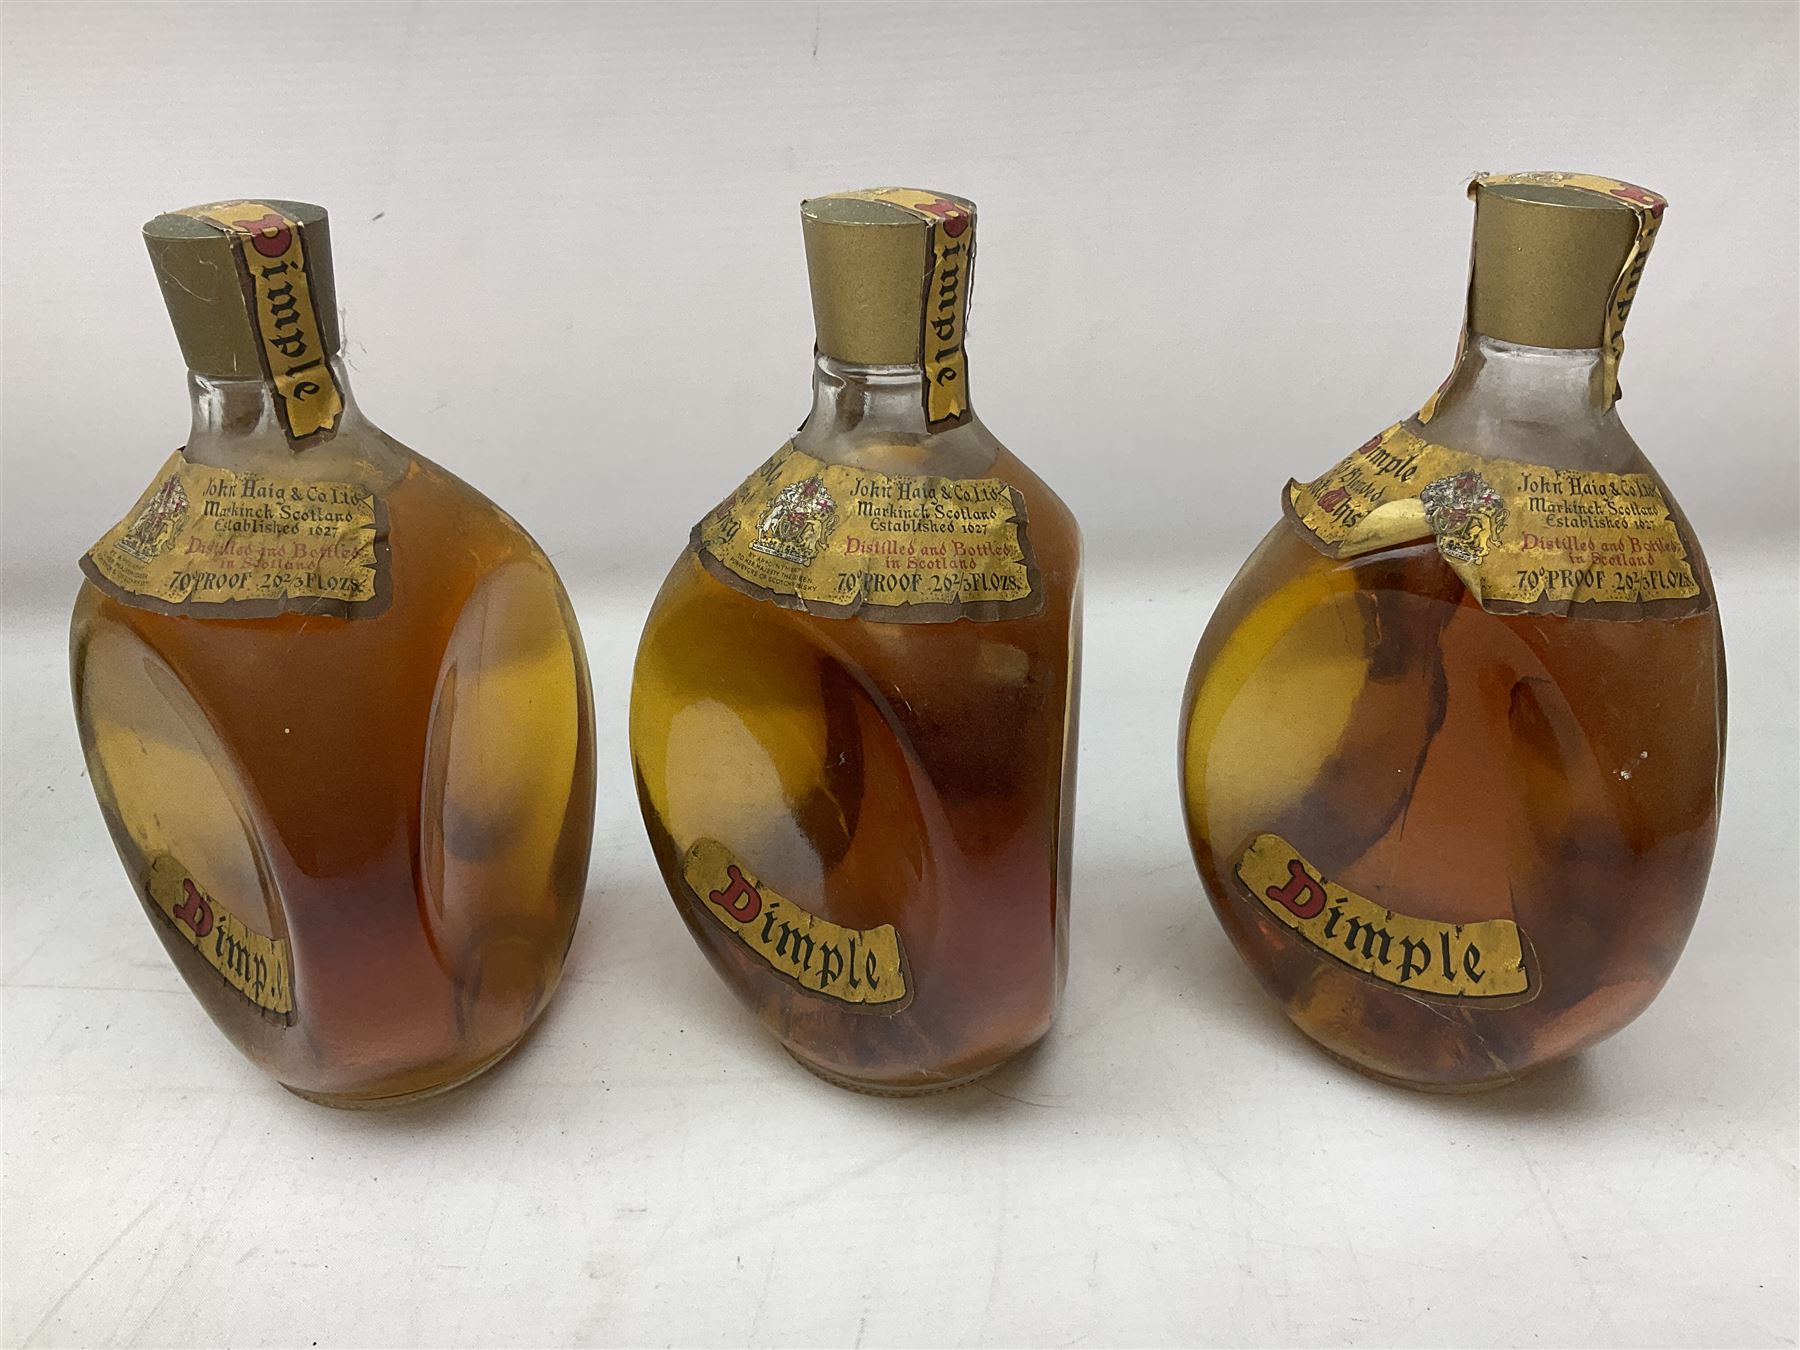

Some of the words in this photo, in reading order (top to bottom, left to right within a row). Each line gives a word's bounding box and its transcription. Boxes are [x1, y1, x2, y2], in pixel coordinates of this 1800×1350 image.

[914, 199, 969, 387] Dimple
[232, 213, 322, 402] Dimple
[203, 478, 236, 497] John
[241, 480, 285, 505] Haig
[291, 487, 303, 501] &
[850, 477, 893, 499] John
[897, 482, 938, 505] Haig
[941, 485, 952, 500] &
[1517, 472, 1563, 495] John
[1569, 477, 1610, 502] Haig
[1609, 482, 1620, 496] &
[203, 501, 273, 519] Markinch
[279, 505, 352, 522] Scotland
[858, 501, 930, 519] Markinch
[935, 505, 997, 520] Scotland
[1529, 496, 1604, 515] Markinch
[1608, 501, 1659, 516] Scotland
[214, 518, 300, 534] Established
[309, 526, 338, 537] 1627
[870, 518, 955, 533] Established
[963, 524, 987, 535] 1627
[1546, 514, 1629, 529] Established
[1634, 520, 1655, 530] 1627
[185, 536, 250, 556] Distilled
[257, 542, 284, 558] and
[293, 543, 364, 559] Bottled
[844, 536, 915, 556] Distilled
[920, 540, 946, 556] and
[952, 540, 1011, 557] Bottled
[1521, 531, 1596, 552] Distilled
[1601, 537, 1625, 551] and
[1628, 536, 1681, 553] Bottled
[220, 557, 233, 569] in
[240, 557, 316, 570] Scotland
[745, 558, 755, 567] HER
[756, 563, 780, 576] MAJESTY
[886, 557, 900, 569] in
[907, 556, 977, 570] Scotland
[1569, 552, 1585, 565] in
[1591, 552, 1655, 567] Scotland
[709, 864, 880, 990] Dimple
[1266, 859, 1486, 984] Dimple
[173, 878, 284, 1000] Dimpe
